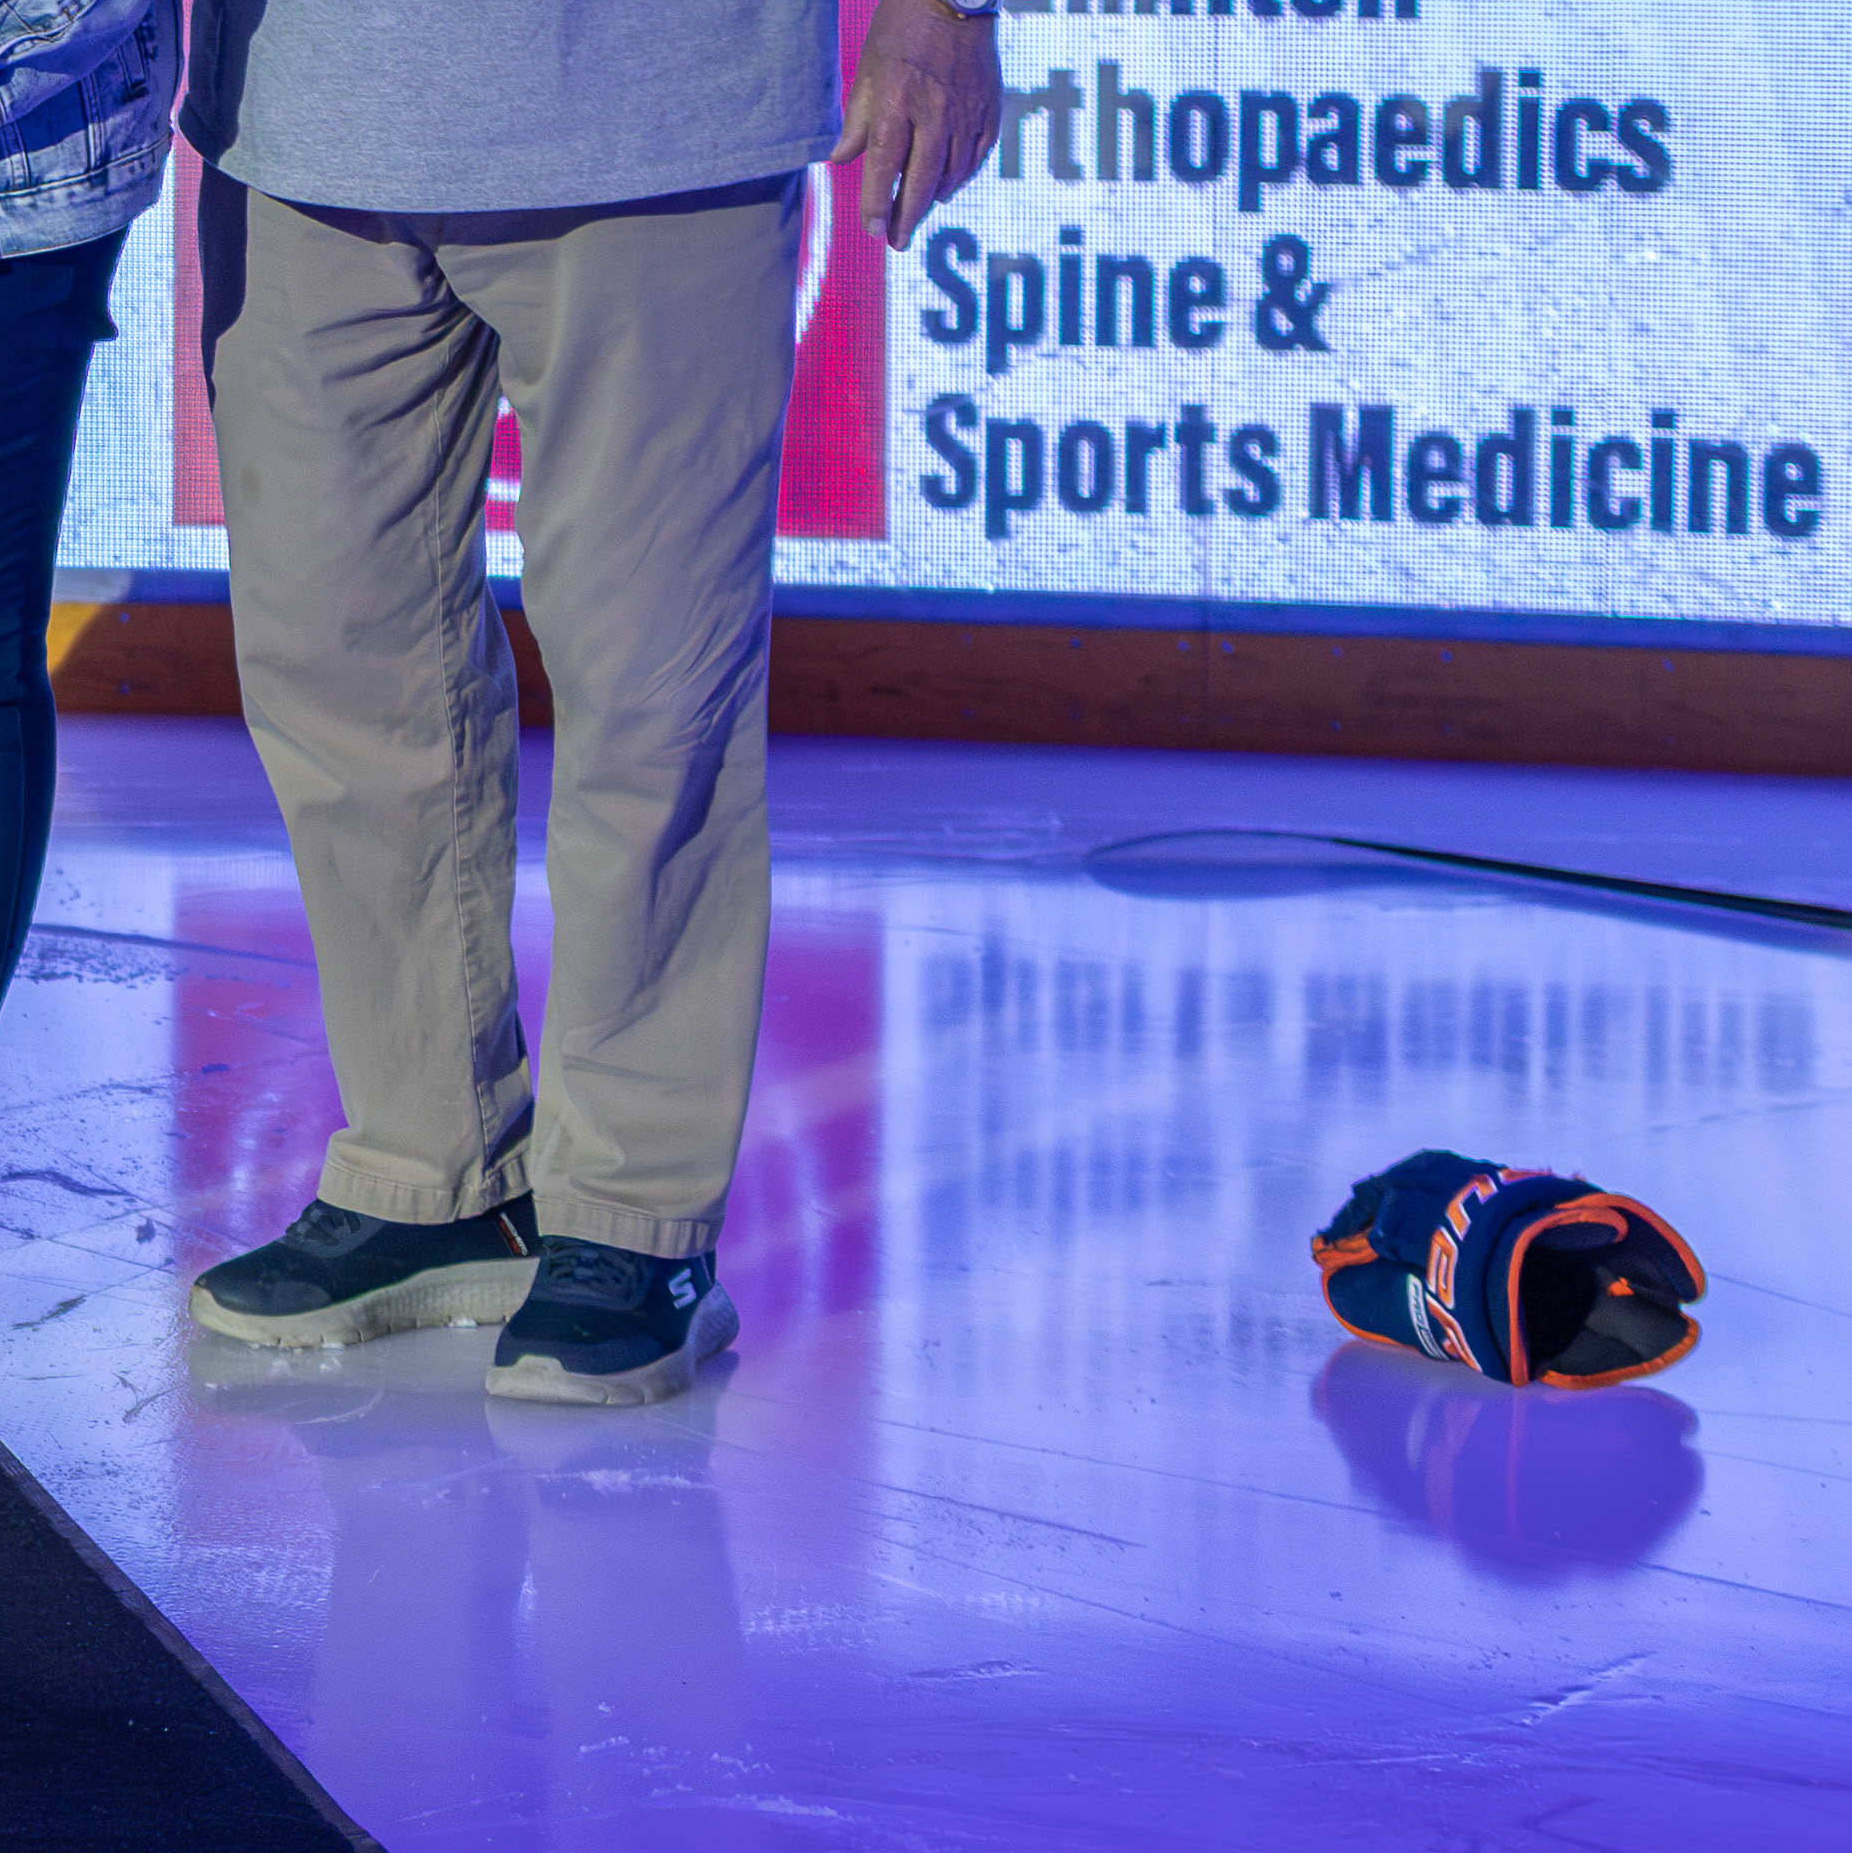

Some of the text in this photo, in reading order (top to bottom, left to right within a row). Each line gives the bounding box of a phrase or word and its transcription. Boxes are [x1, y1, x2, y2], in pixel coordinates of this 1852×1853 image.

[999, 60, 1673, 214] rthopaedics
[919, 225, 1333, 375] Spine &
[919, 392, 1824, 542] Sports Medicine
